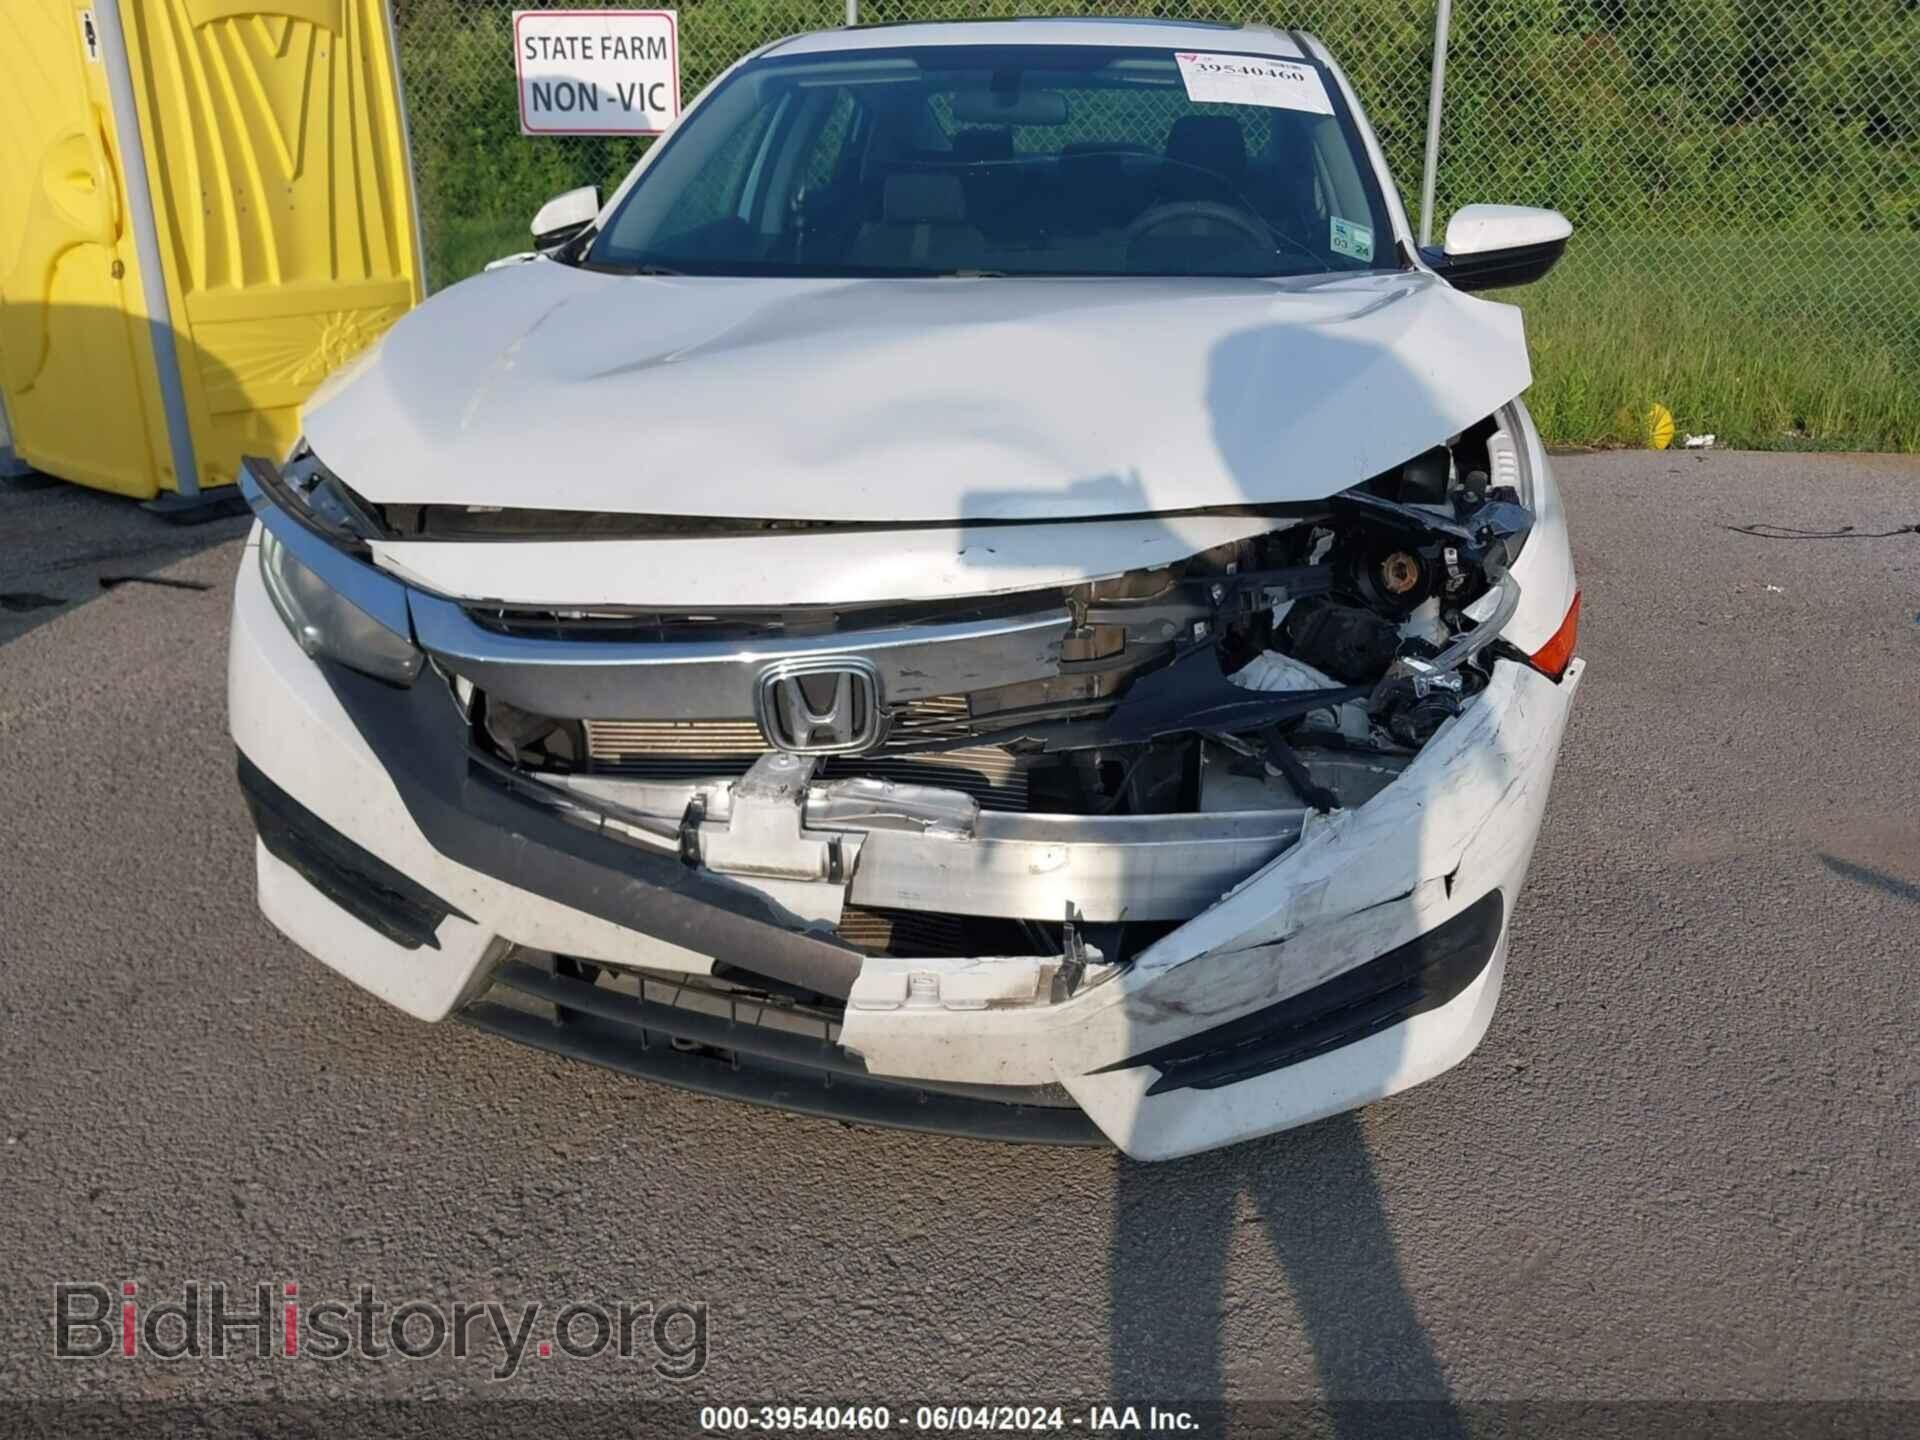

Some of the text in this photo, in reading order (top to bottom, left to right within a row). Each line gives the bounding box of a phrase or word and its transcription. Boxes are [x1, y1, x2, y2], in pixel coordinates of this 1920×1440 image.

[525, 36, 667, 60] STATE FARM
[1196, 63, 1305, 82] 39540460
[532, 82, 599, 112] NON
